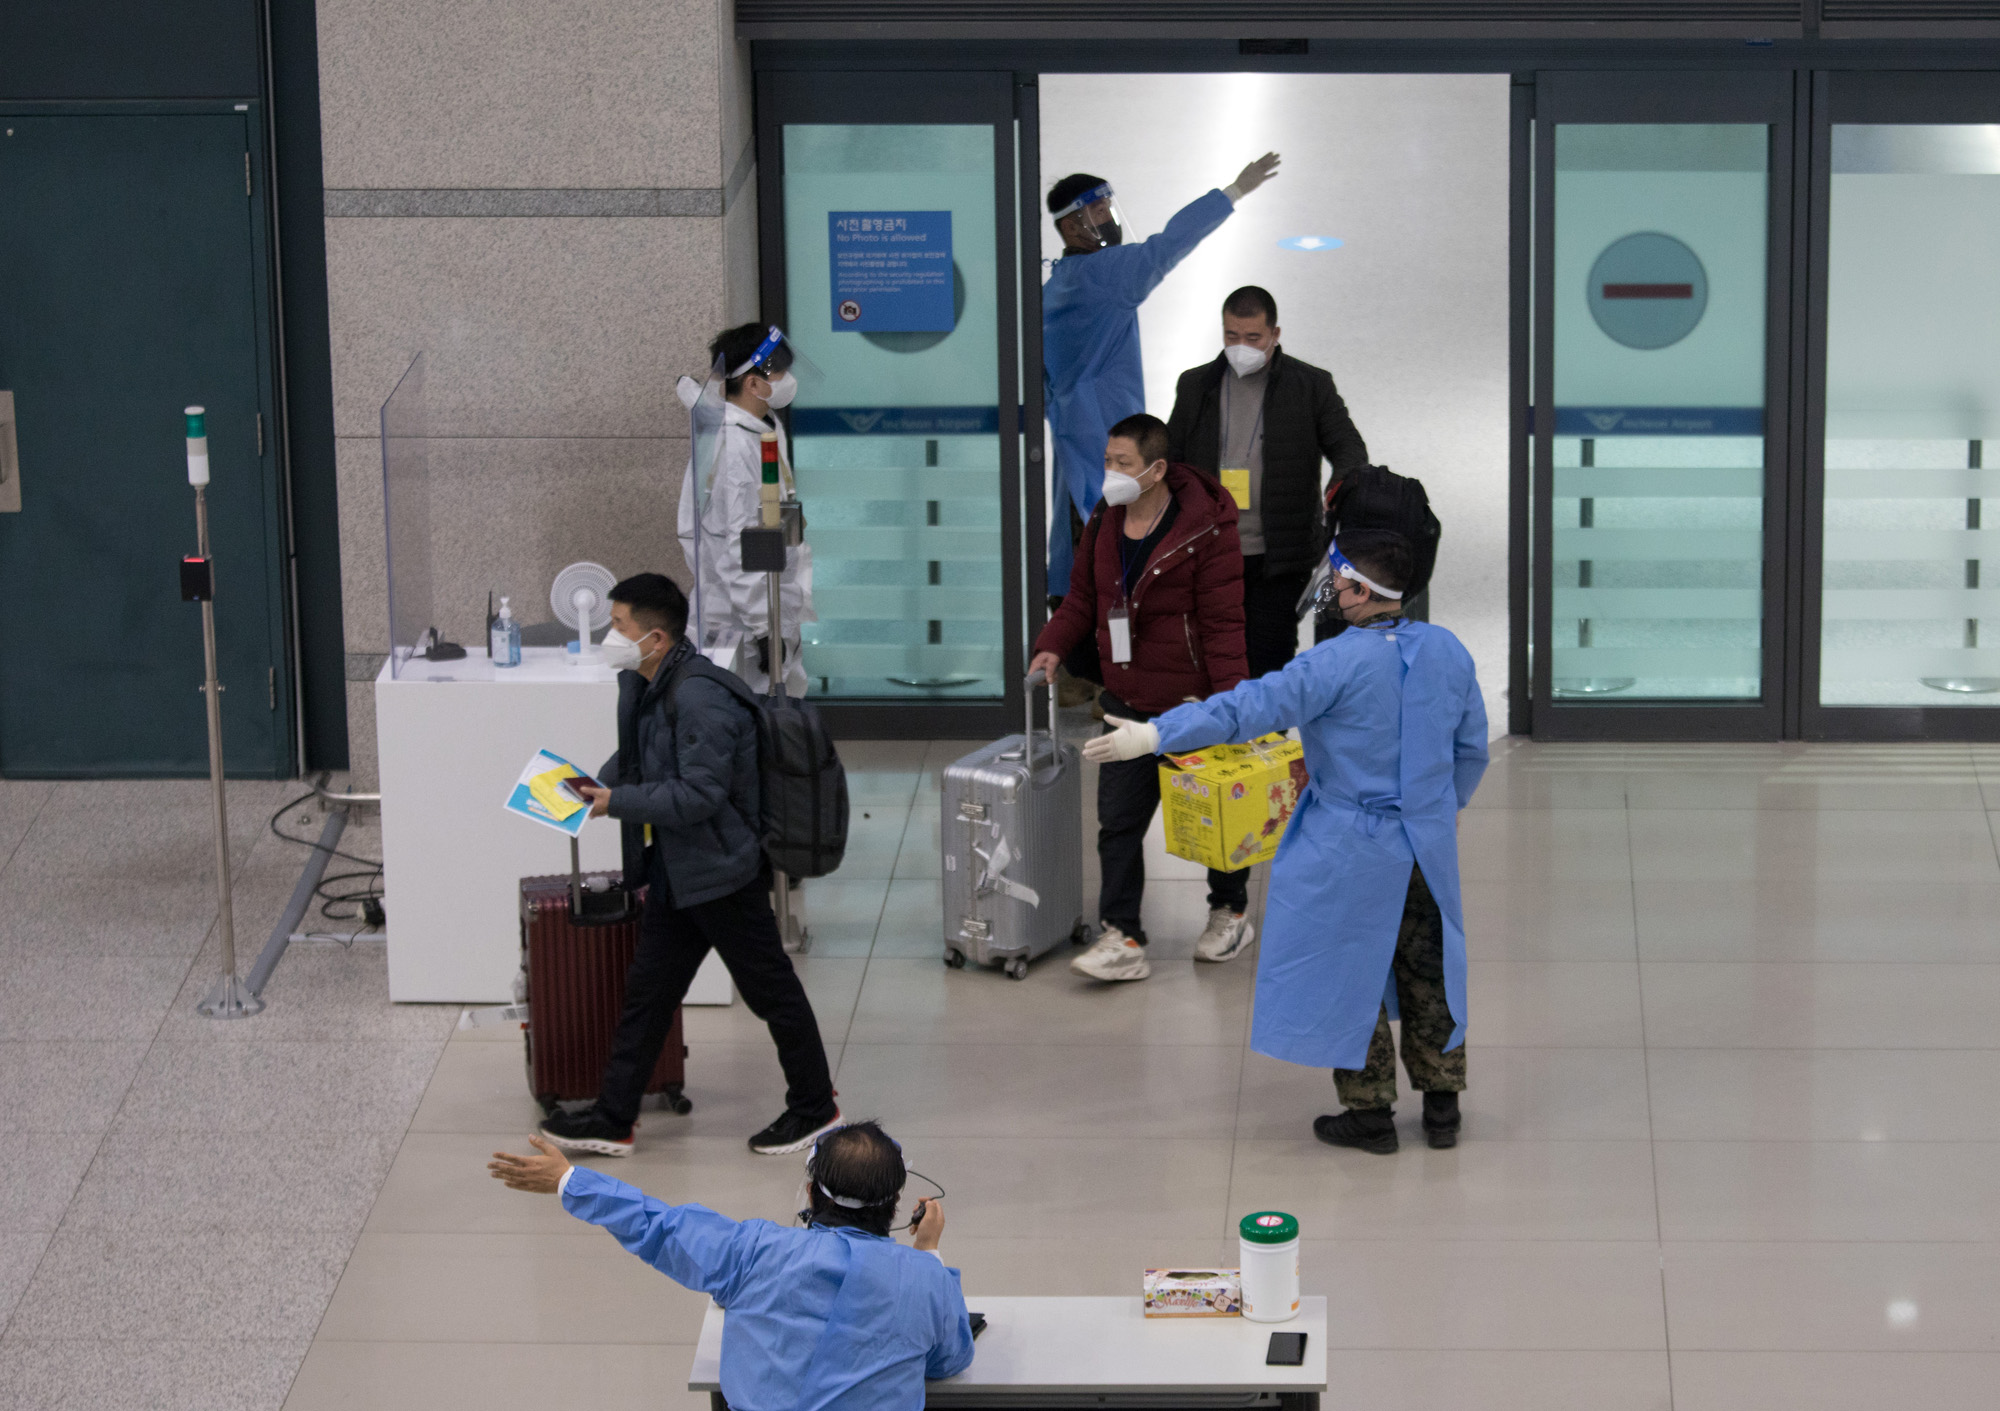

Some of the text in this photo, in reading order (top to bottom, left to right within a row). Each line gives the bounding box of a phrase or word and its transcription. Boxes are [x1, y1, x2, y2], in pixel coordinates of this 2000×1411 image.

[837, 233, 927, 242] No Photo is allowed
